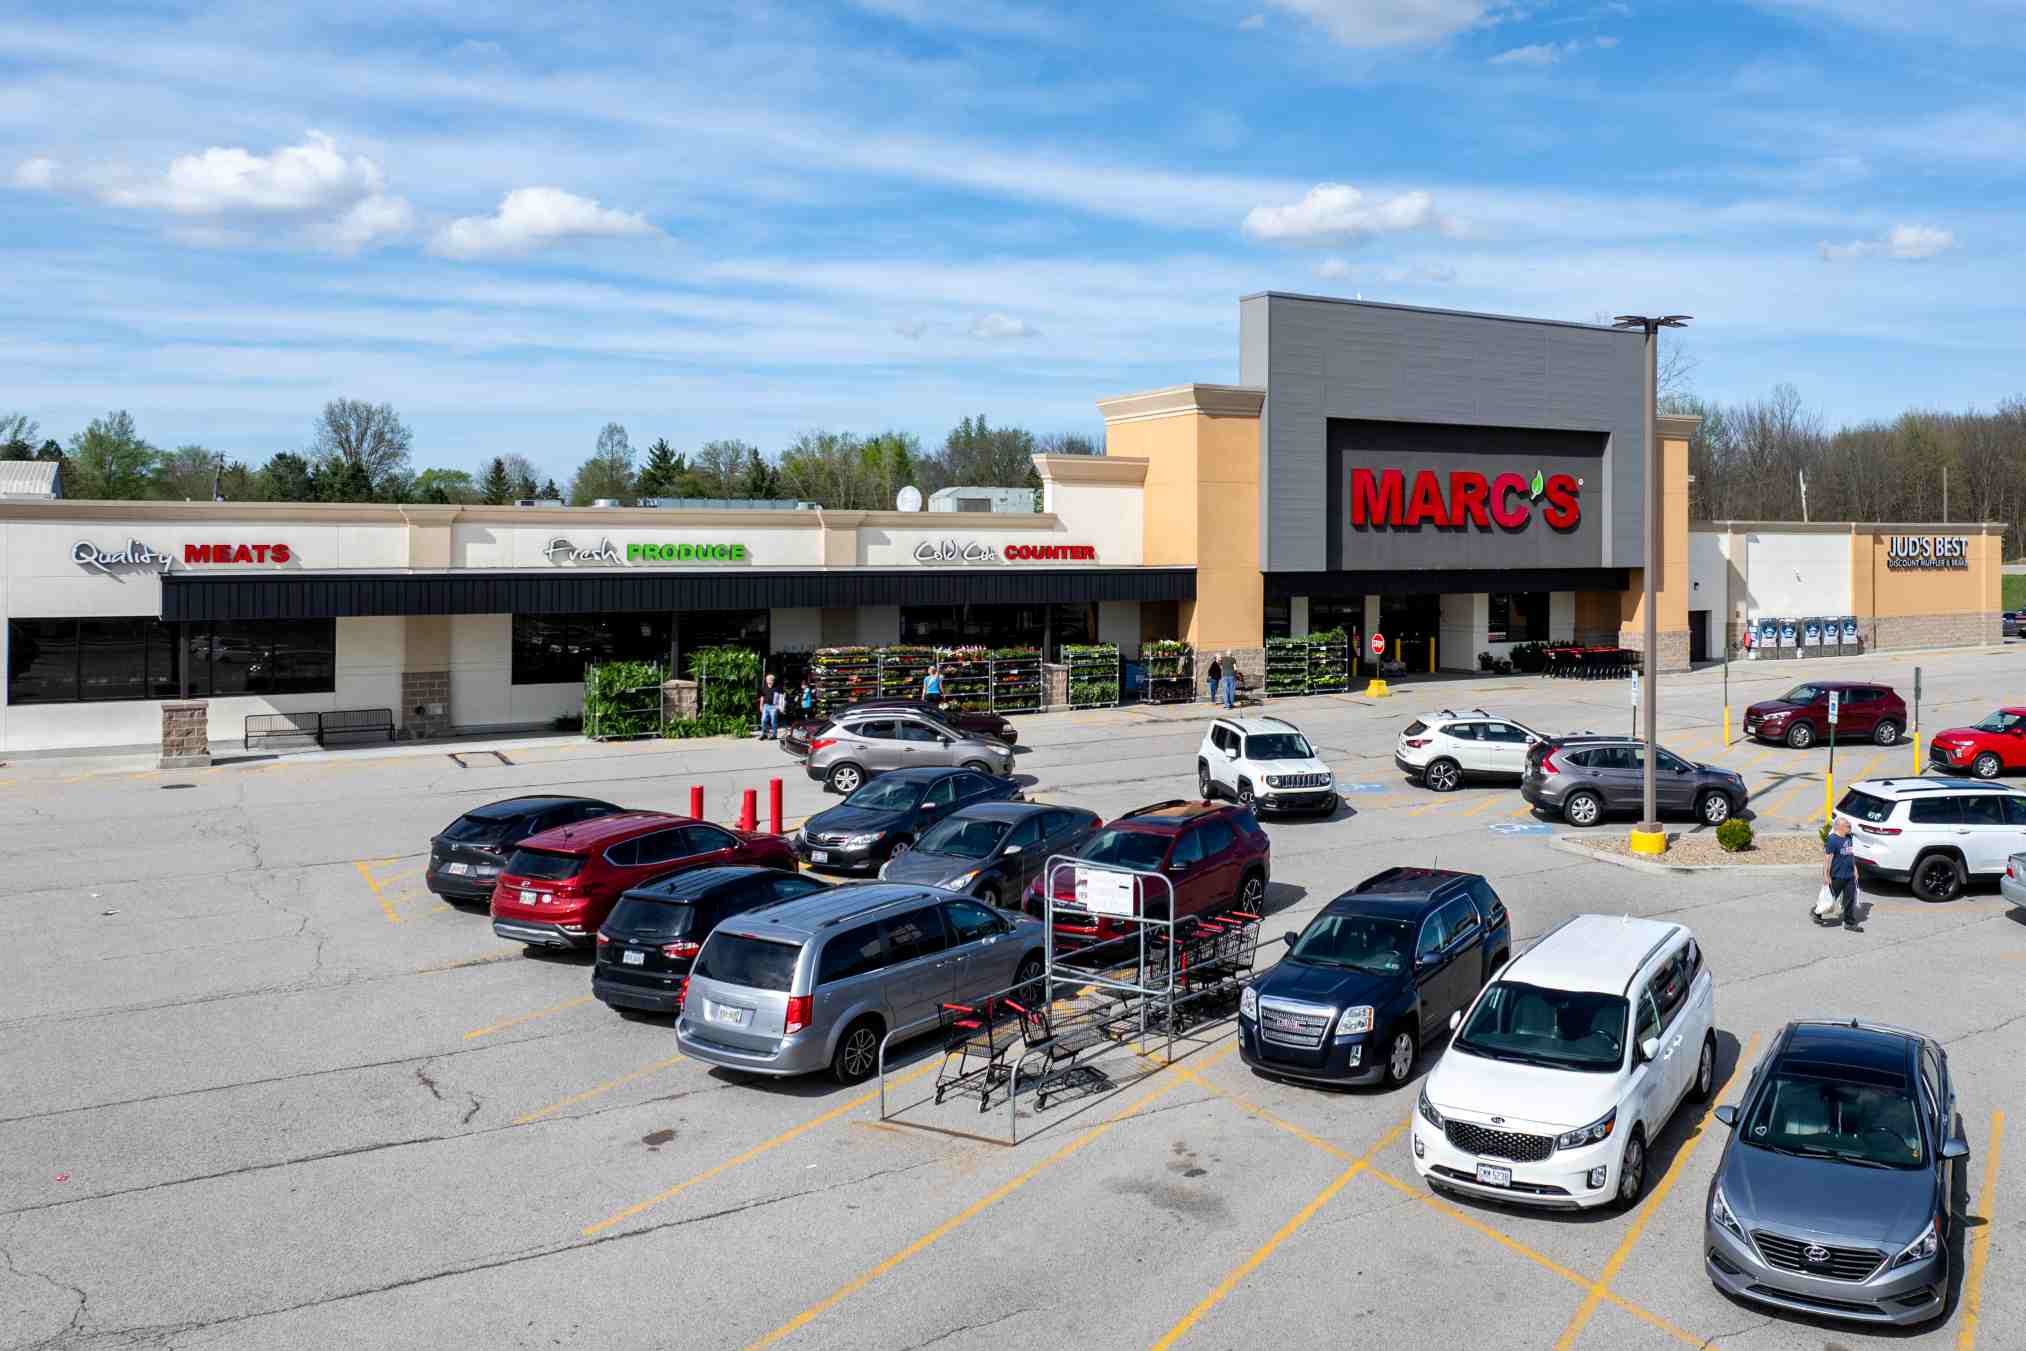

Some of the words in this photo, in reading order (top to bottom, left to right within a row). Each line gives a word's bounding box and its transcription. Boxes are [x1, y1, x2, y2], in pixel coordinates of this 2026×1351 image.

[72, 537, 173, 577] Quality
[184, 543, 291, 564] MEATS
[545, 537, 623, 566] Fresh
[626, 543, 747, 562] PRODUCE
[1003, 545, 1096, 561] COUNTER
[1888, 536, 1930, 557] JUD'S
[1935, 536, 1968, 557] BEST
[1889, 559, 1919, 568] DISCOUNT
